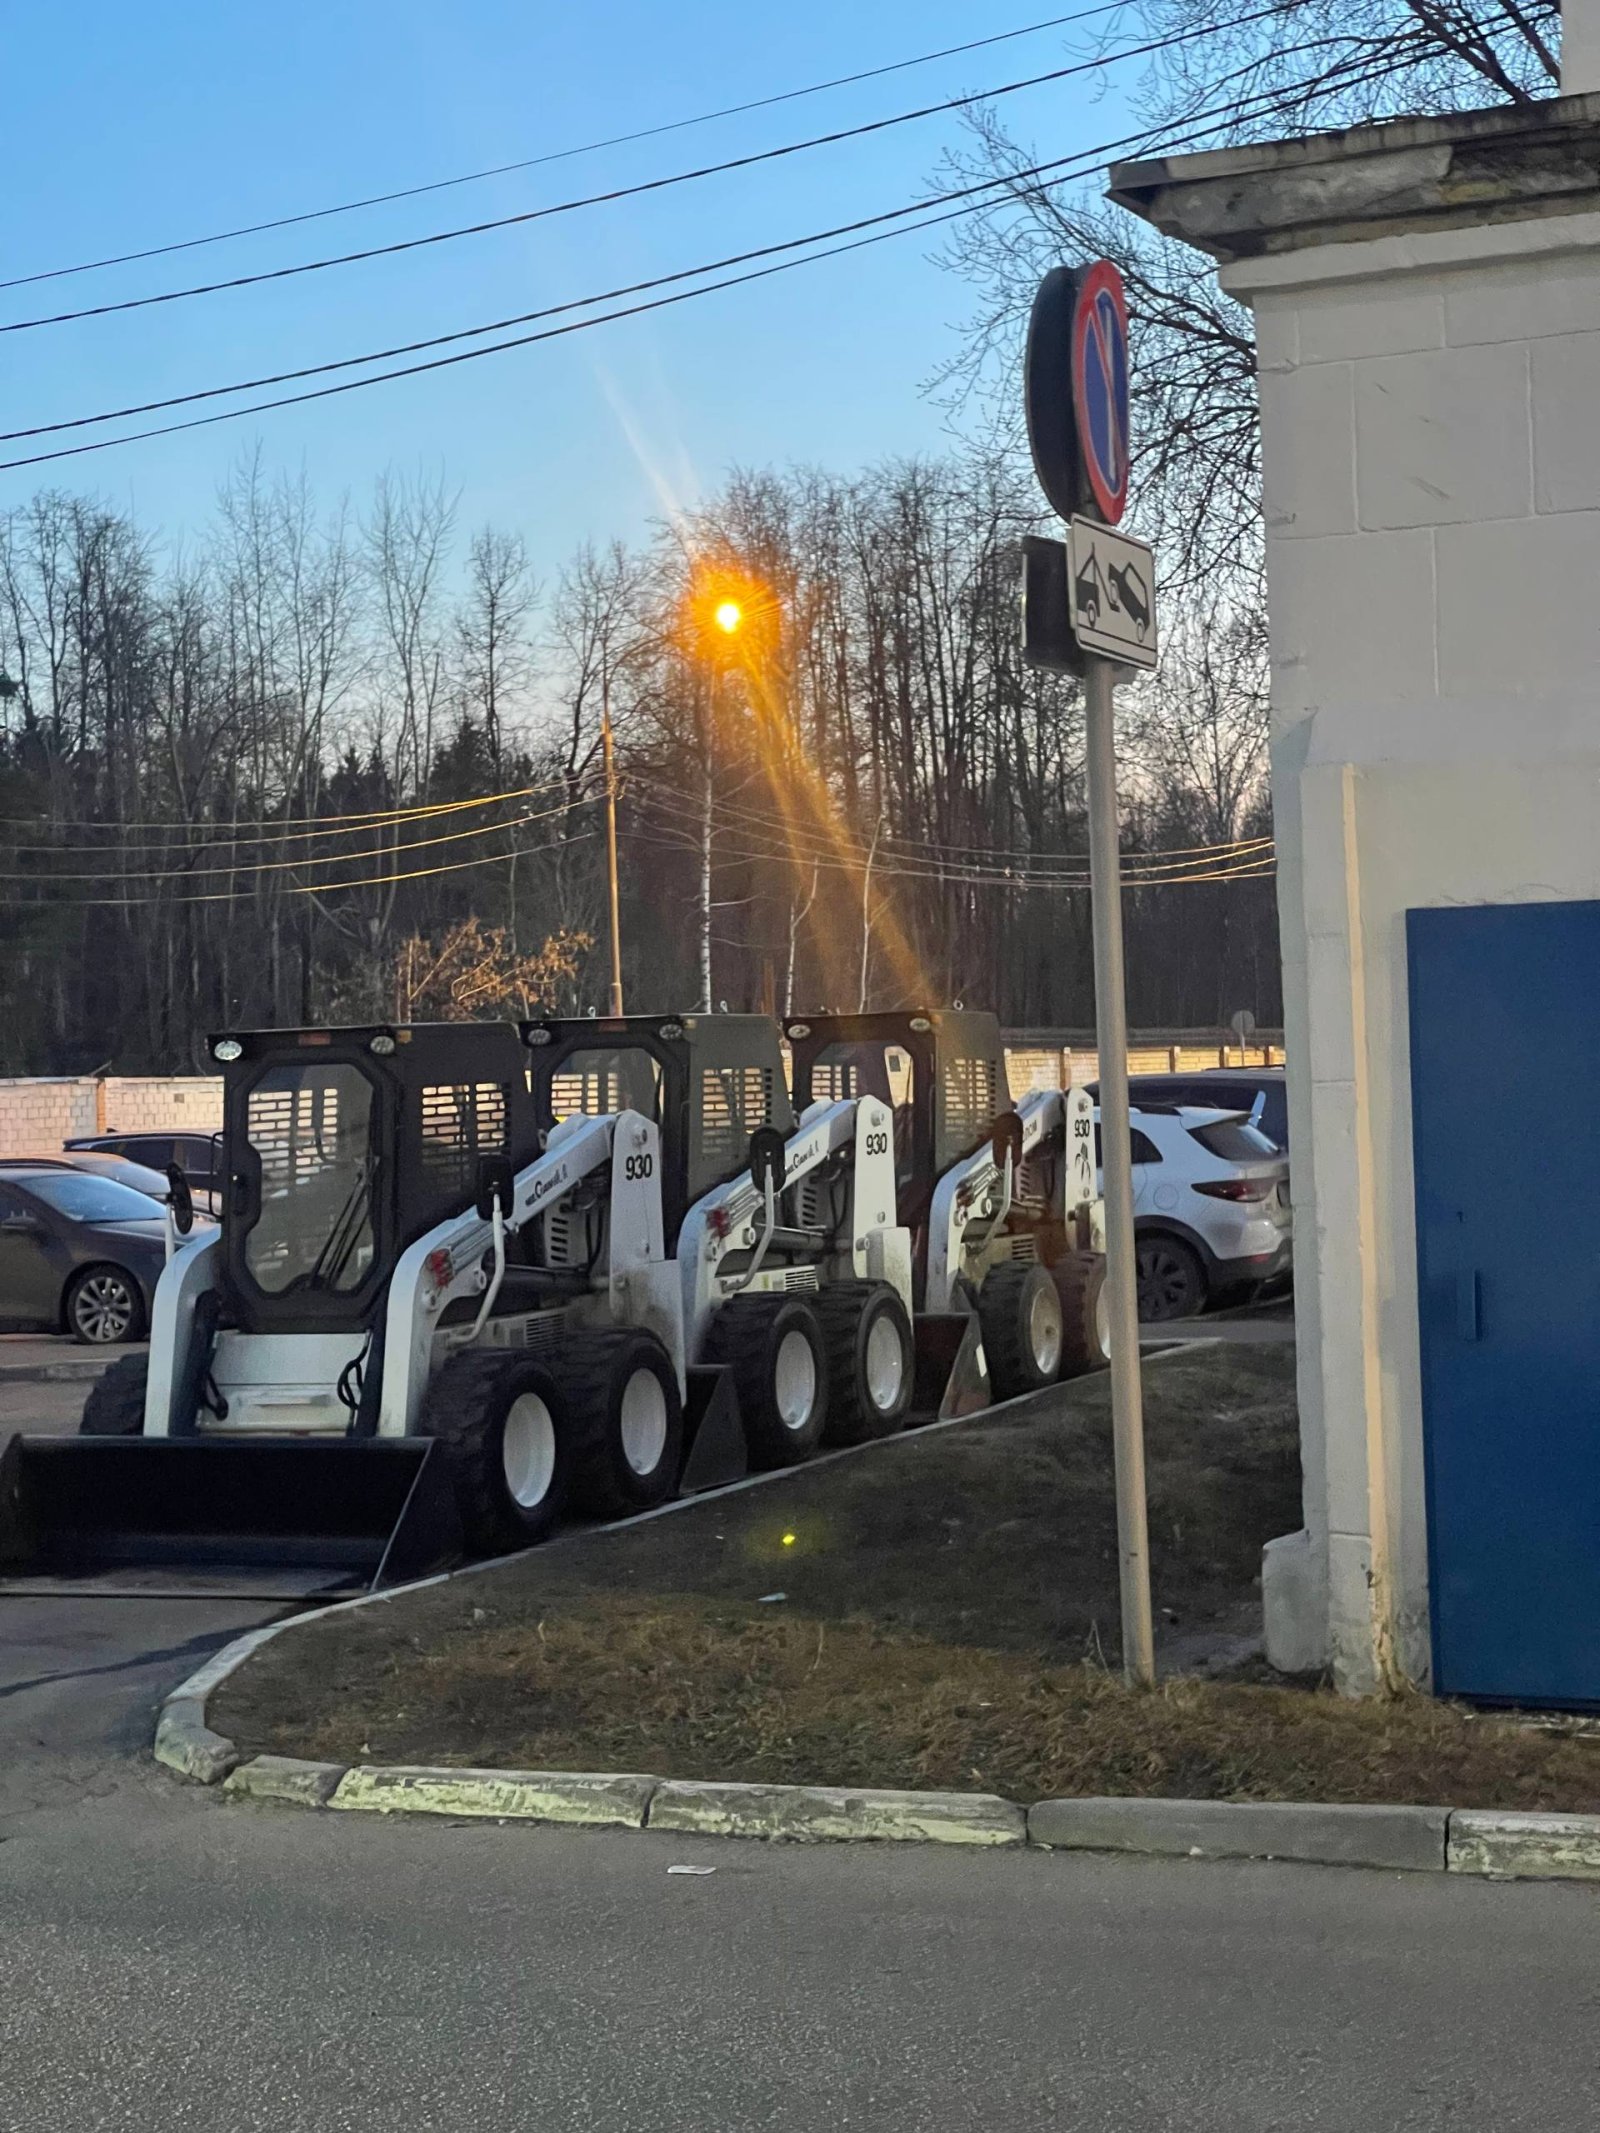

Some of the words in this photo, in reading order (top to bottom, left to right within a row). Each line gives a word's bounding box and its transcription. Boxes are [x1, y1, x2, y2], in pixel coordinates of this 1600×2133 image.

[1074, 1119, 1090, 1138] 930
[866, 1132, 888, 1156] 930
[625, 1153, 653, 1181] 930
